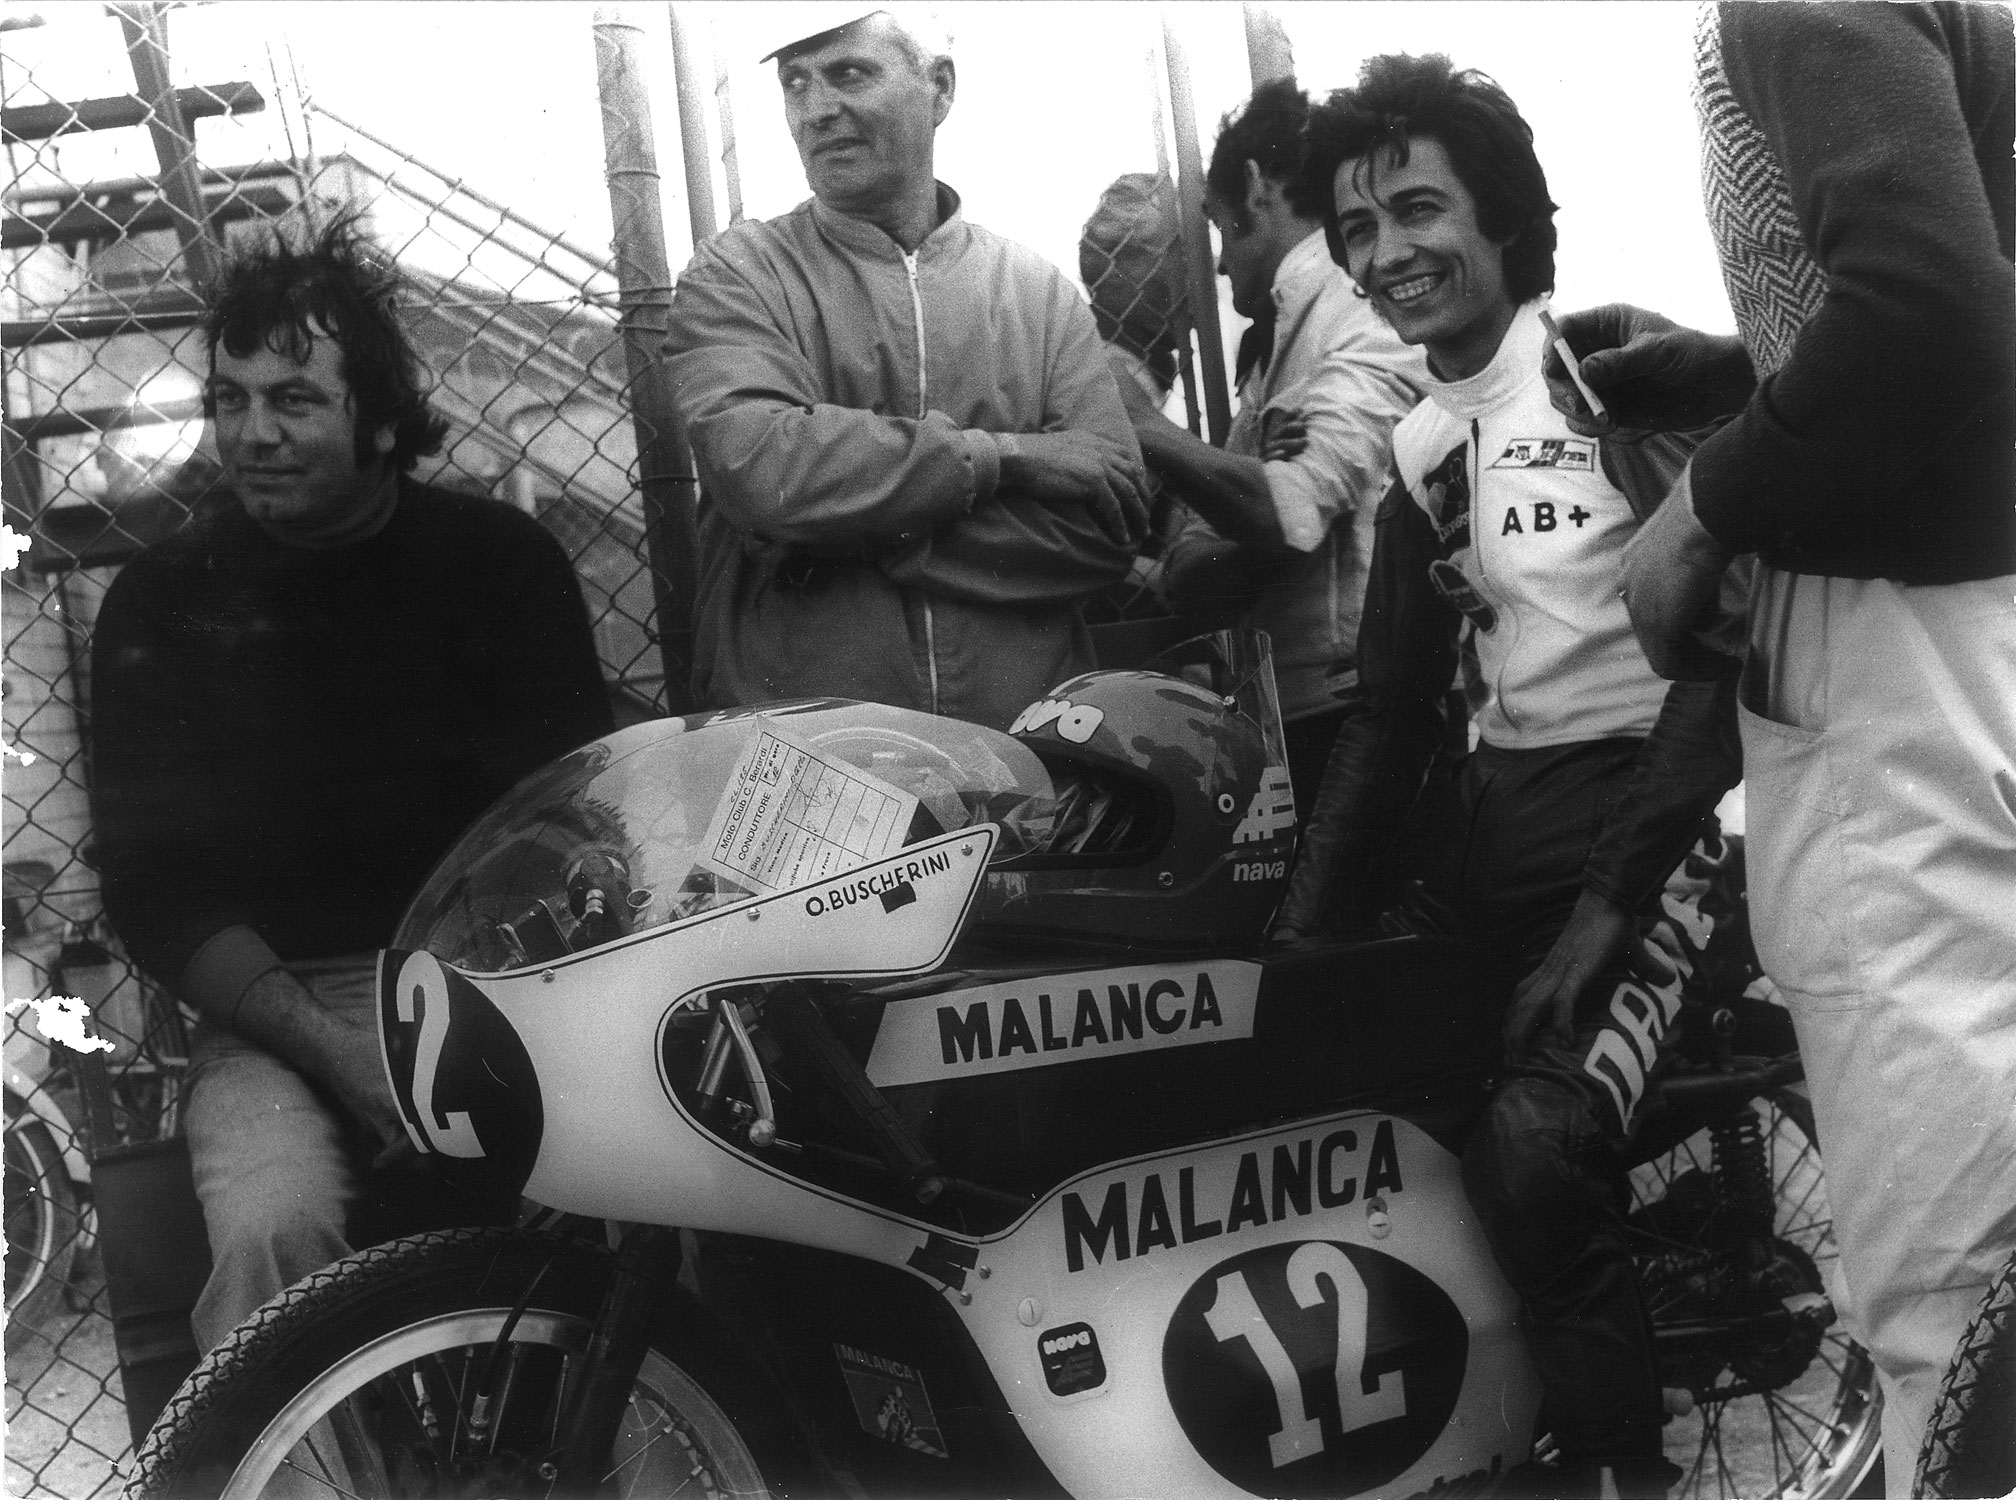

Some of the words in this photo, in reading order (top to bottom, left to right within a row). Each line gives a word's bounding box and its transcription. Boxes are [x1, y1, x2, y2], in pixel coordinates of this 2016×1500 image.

[721, 824, 736, 849] Moto
[732, 799, 746, 821] Club
[743, 785, 752, 796] C.
[749, 747, 768, 782] Berardi
[738, 792, 771, 861] CONDUTTORE
[1234, 860, 1285, 882] nava
[376, 949, 488, 1158] 2
[937, 972, 1223, 1064] MALANCA
[1062, 1120, 1403, 1273] MALANCA
[841, 1343, 915, 1381] MALANCA
[1203, 1241, 1407, 1469] 12
